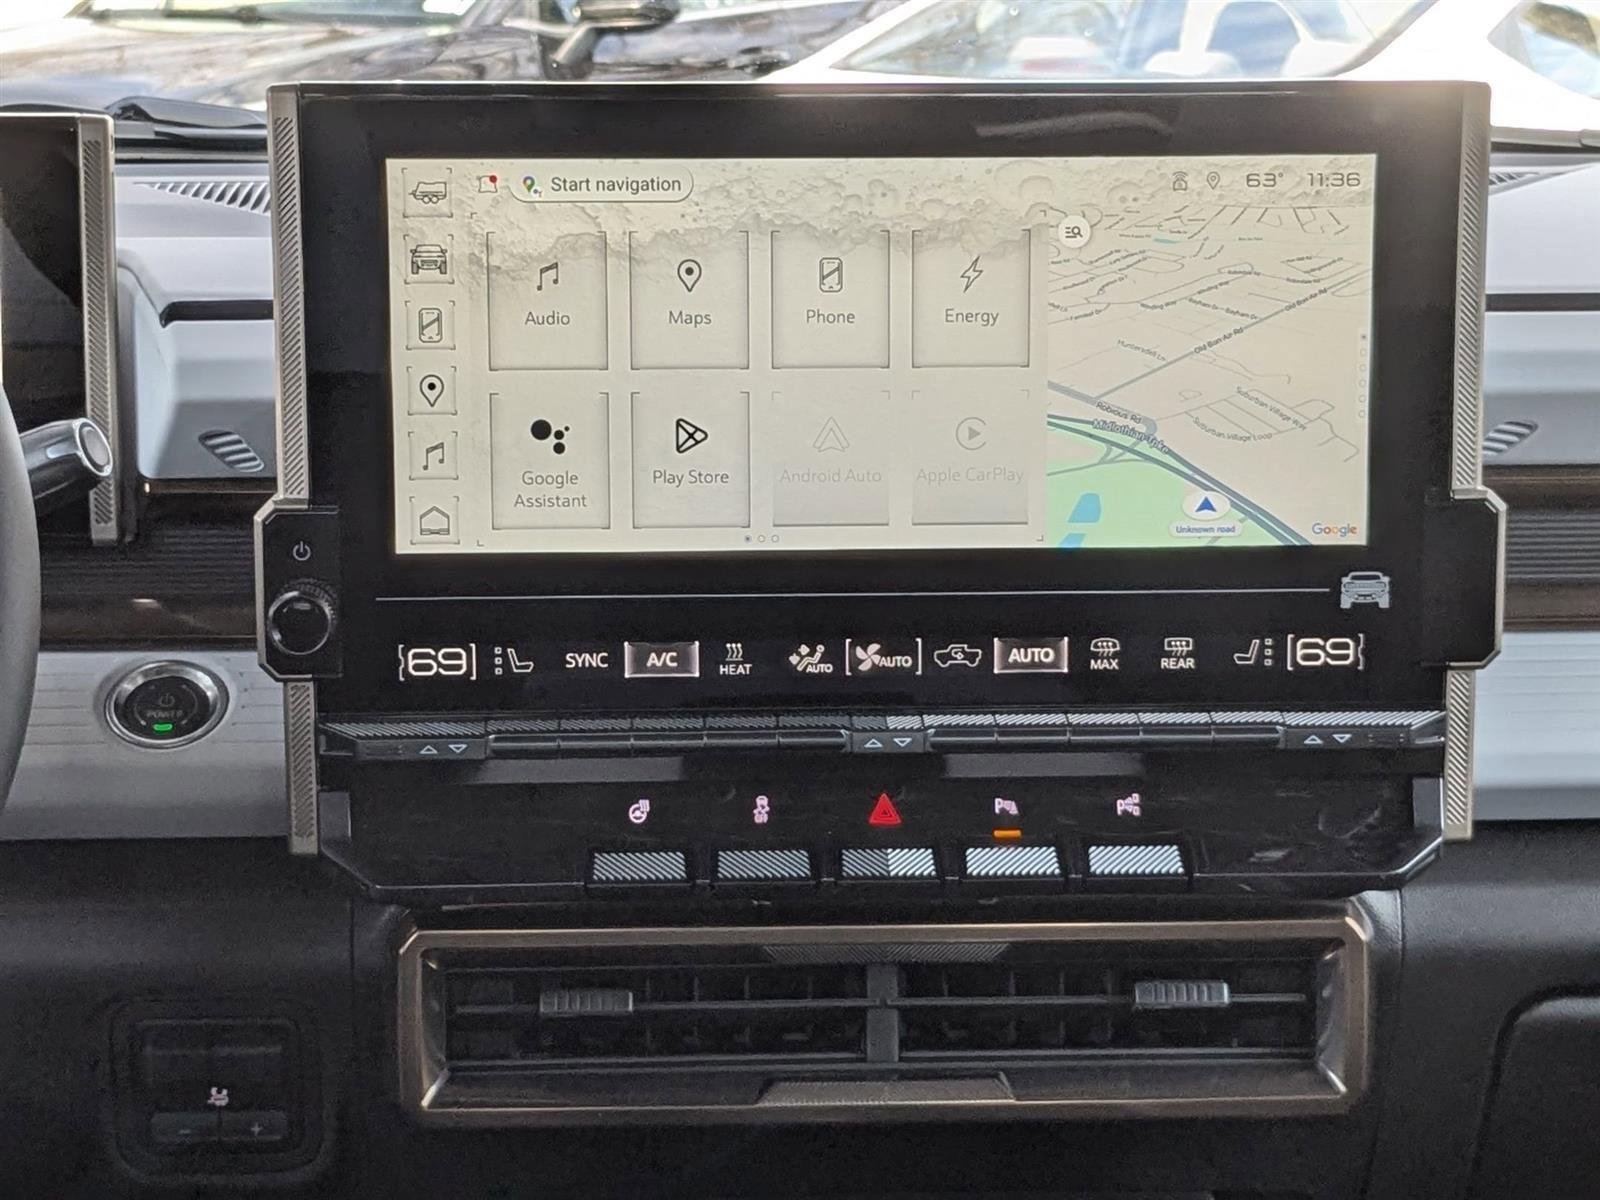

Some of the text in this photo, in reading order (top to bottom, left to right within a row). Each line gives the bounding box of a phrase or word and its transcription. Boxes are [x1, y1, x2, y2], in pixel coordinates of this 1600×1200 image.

[551, 176, 682, 195] Start navigation
[1246, 172, 1284, 188] 63°
[1307, 172, 1361, 188] 11:36
[524, 310, 571, 326] Audio
[668, 310, 712, 331] Maps
[805, 309, 855, 325] Phone
[944, 308, 999, 327] Energy
[1194, 343, 1207, 354] Old
[1233, 327, 1244, 336] Rd
[1236, 386, 1268, 409] Suburban
[1130, 414, 1143, 424] Rd
[1092, 418, 1147, 442] Midlothian
[1193, 417, 1273, 442] Suburban Village Loop
[521, 470, 579, 489] Google
[652, 468, 730, 488] Play Store
[780, 468, 882, 484] Android Auto
[916, 466, 1024, 487] Apple CarPlay
[513, 494, 587, 508] Assistant
[1175, 525, 1236, 534] Unknown road
[1312, 522, 1357, 537] Google
[646, 651, 679, 668] A/C
[1008, 648, 1055, 664] AUTO
[1296, 637, 1355, 667] 69
[407, 647, 468, 677] 69
[565, 652, 609, 669] SYNC
[806, 662, 833, 674] AUTO
[879, 655, 913, 668] AUTO
[1089, 658, 1119, 670] MAX
[1160, 657, 1195, 670] REAR
[719, 663, 752, 677] HEAT
